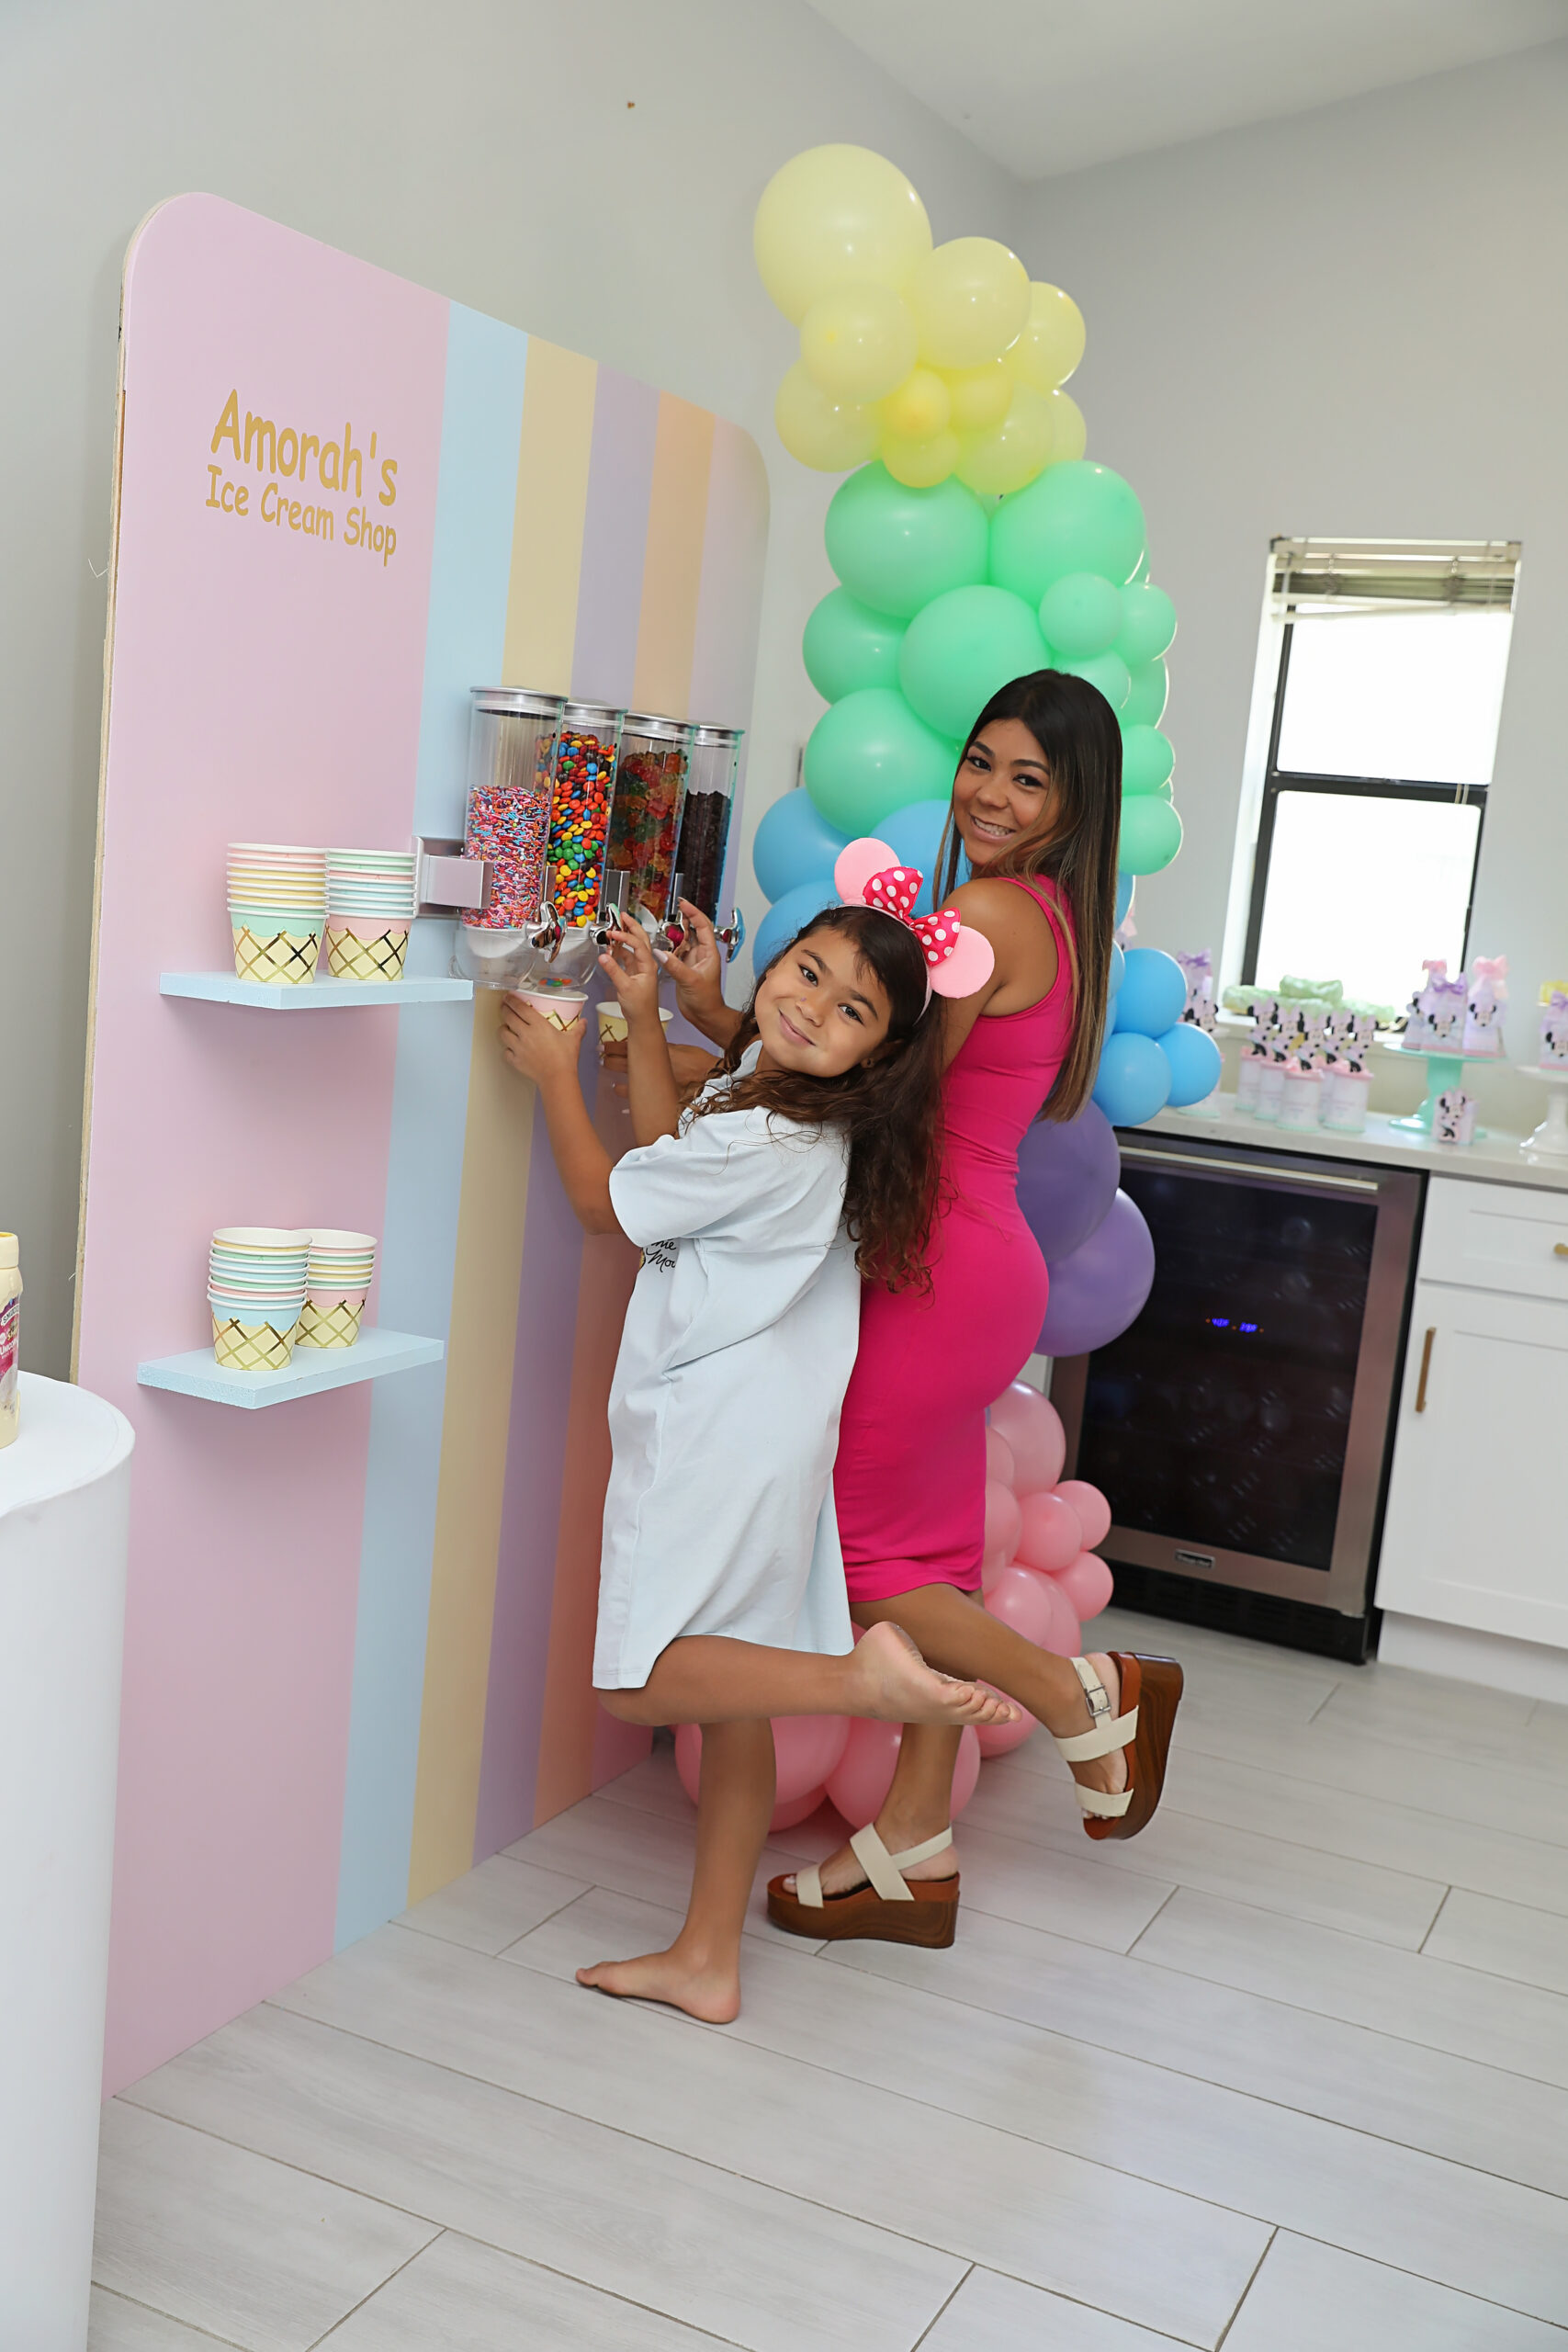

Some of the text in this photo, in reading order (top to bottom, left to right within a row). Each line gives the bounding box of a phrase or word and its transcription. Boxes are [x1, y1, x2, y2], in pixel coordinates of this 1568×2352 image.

[210, 389, 398, 506] Amorah's
[206, 464, 397, 567] Ice Cream Shop
